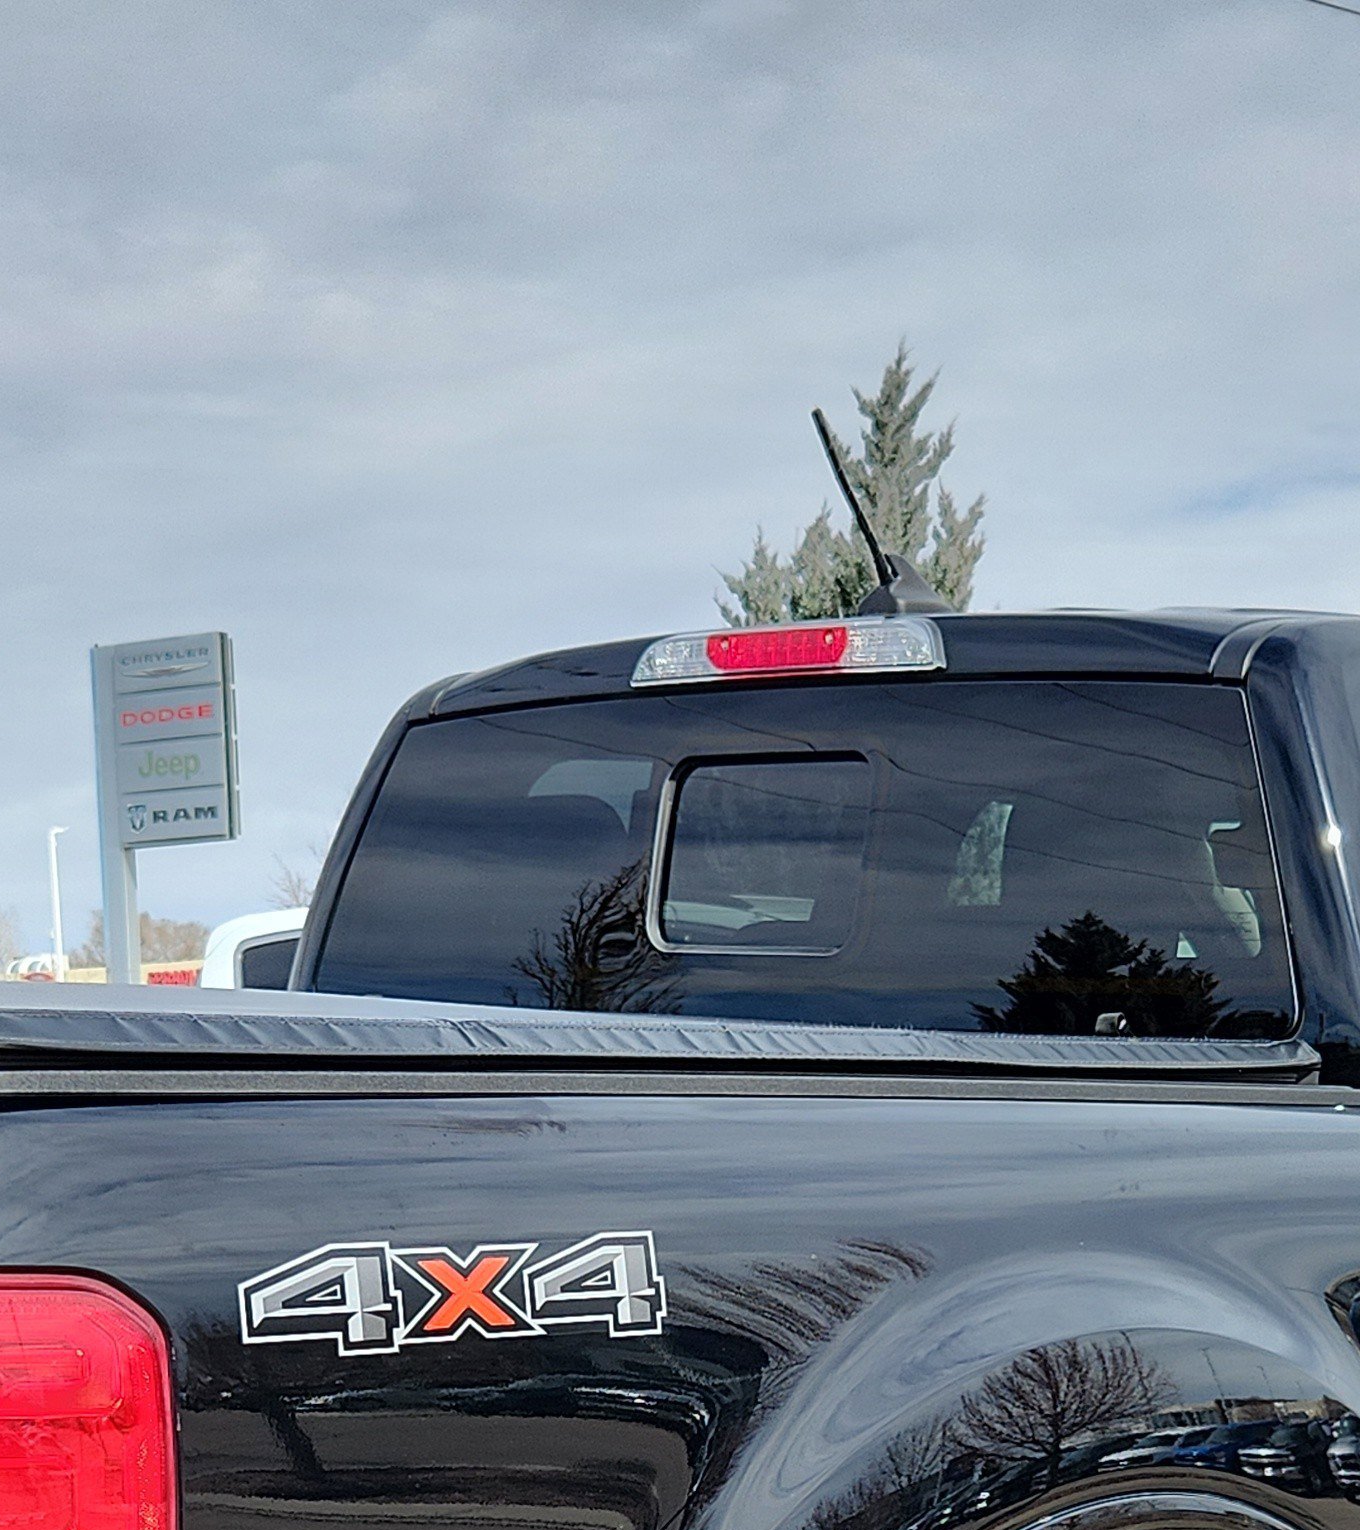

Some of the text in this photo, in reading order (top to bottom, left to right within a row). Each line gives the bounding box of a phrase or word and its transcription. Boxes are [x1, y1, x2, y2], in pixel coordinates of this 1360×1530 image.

[120, 646, 209, 667] CHRYSLER
[121, 703, 215, 729] DODGE
[138, 751, 201, 780] Jeep
[152, 805, 219, 825] RAM
[236, 1230, 668, 1357] 4X4
